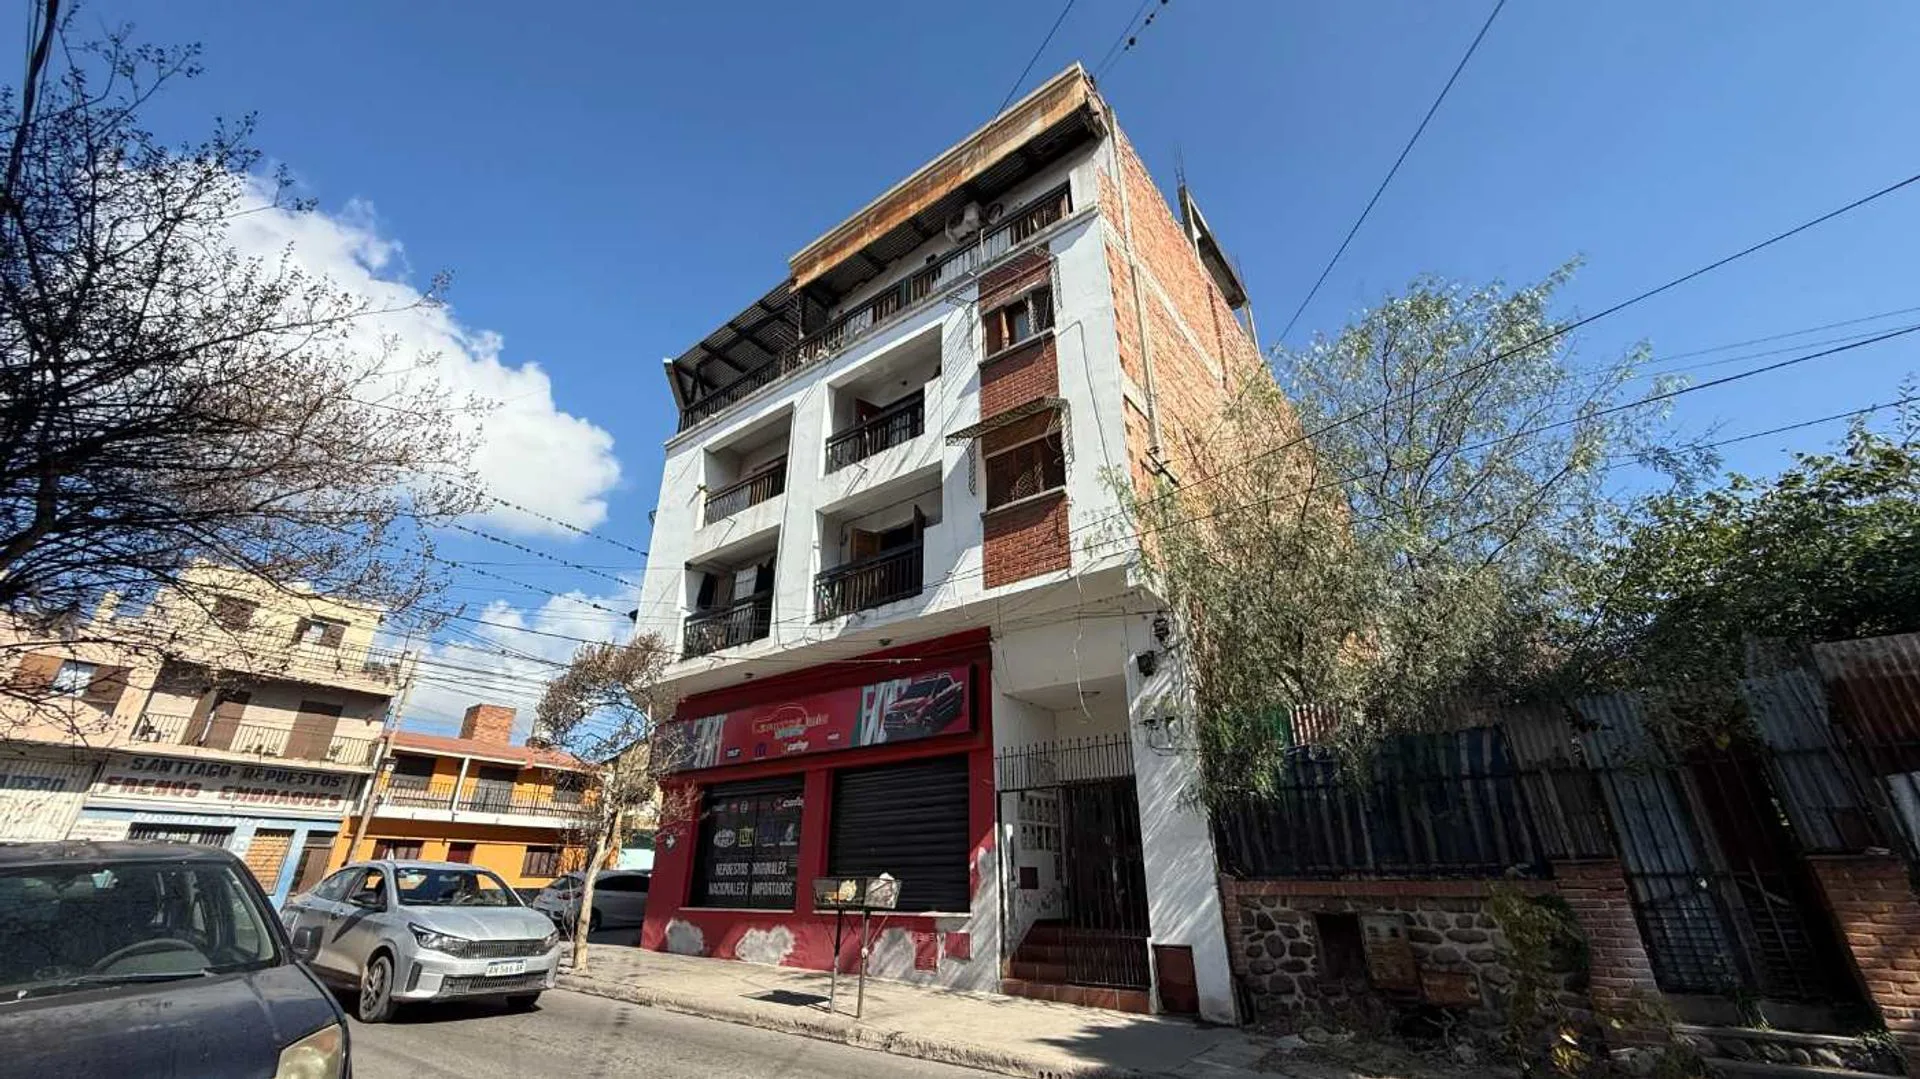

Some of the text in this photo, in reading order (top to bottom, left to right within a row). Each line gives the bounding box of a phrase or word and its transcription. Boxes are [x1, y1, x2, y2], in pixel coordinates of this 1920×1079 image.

[130, 757, 341, 788] SANTIAGO REPUESTOS
[101, 776, 341, 807] FRENOS EMBRAQUES
